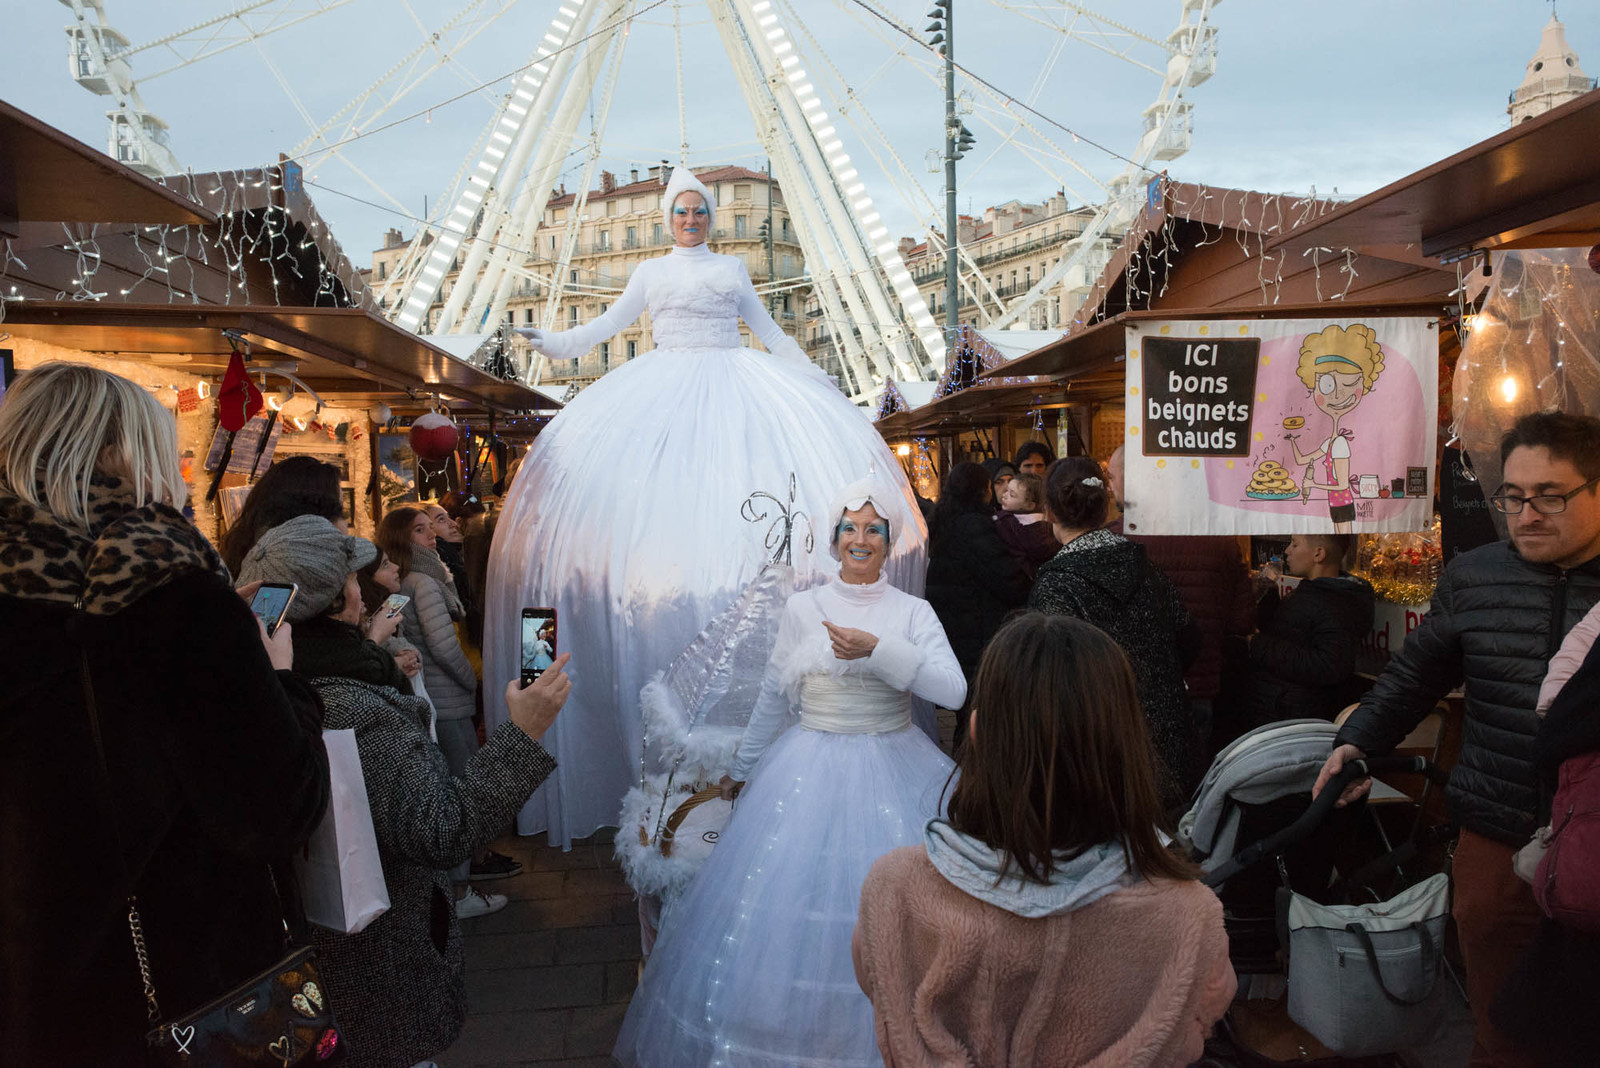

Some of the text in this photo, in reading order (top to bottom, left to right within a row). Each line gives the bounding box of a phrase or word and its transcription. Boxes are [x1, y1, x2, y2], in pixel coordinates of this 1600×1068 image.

[1184, 344, 1218, 366] ICI
[1168, 370, 1228, 394] bons
[1148, 397, 1249, 427] beignets
[1158, 426, 1237, 449] chauds
